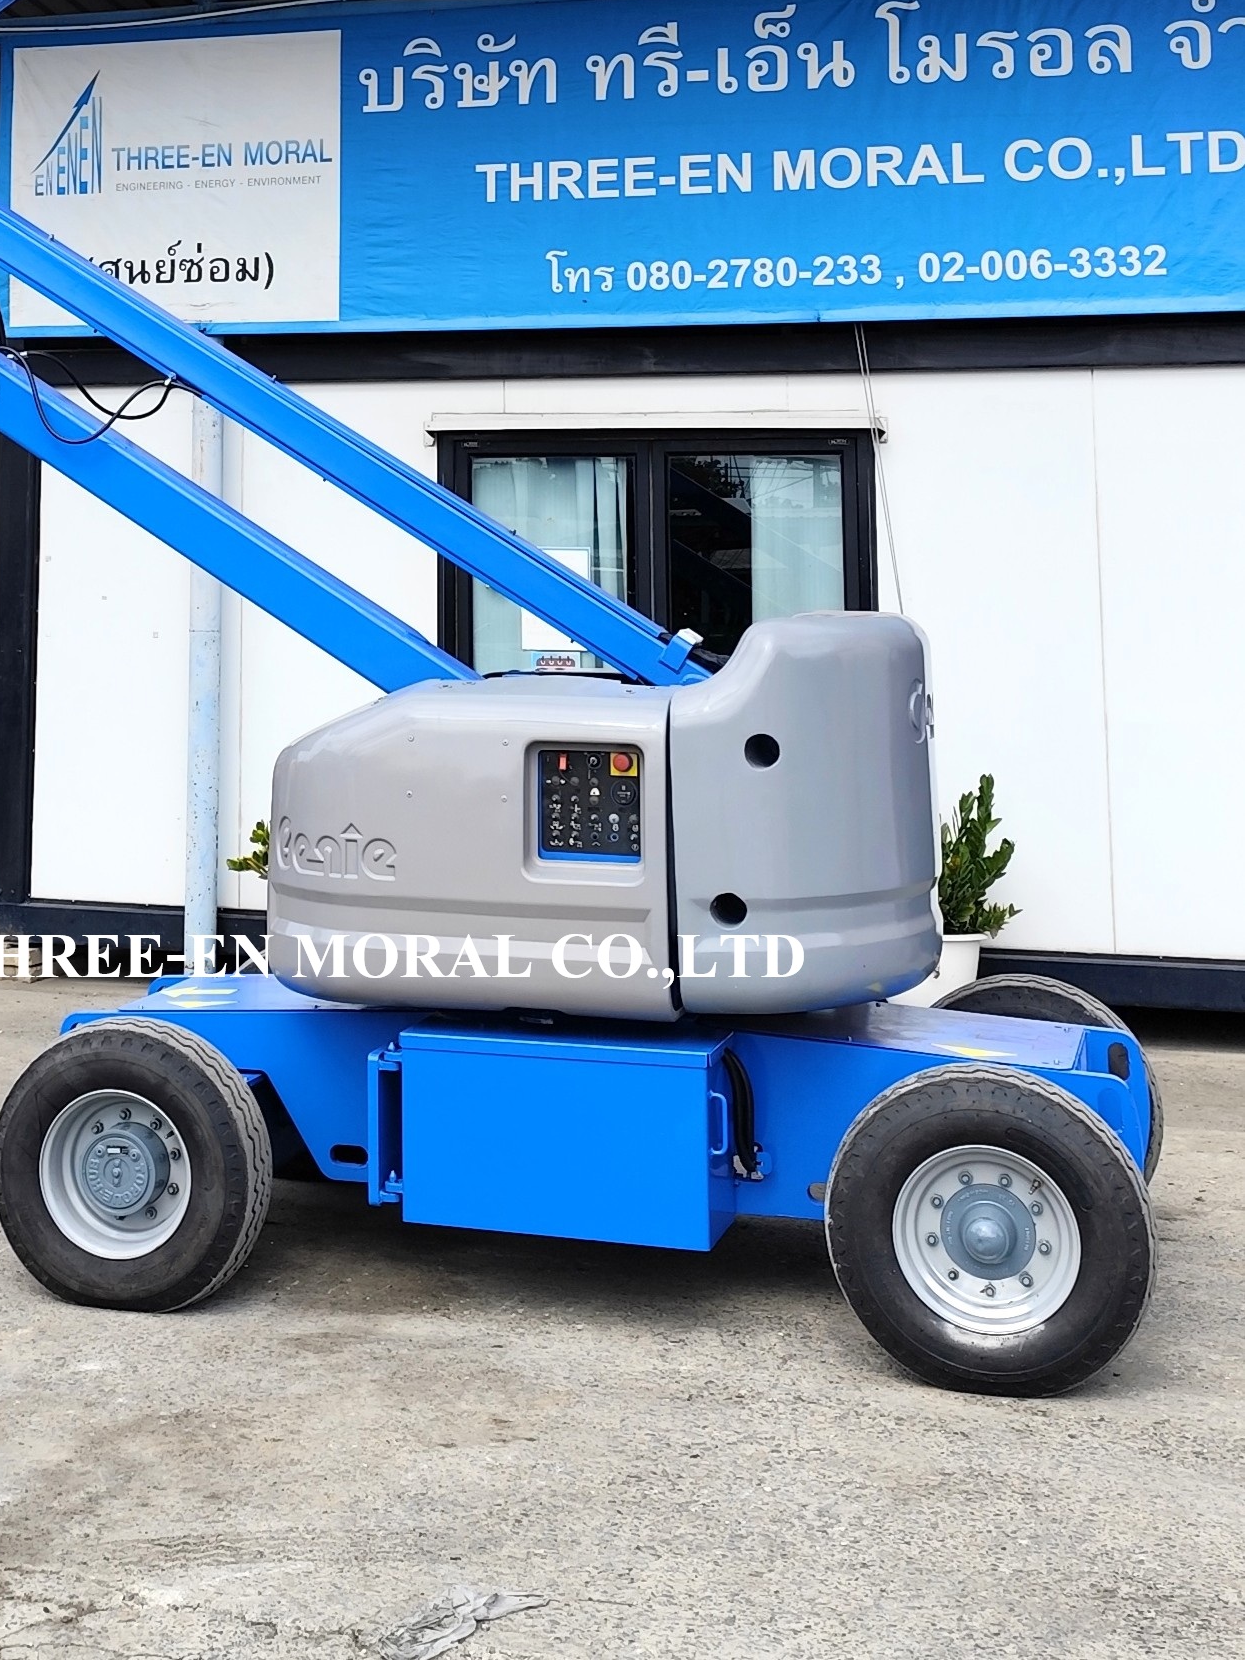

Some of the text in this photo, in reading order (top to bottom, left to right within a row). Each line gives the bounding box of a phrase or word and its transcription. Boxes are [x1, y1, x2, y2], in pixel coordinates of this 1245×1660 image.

[359, 34, 557, 113] บริษัท
[586, 4, 855, 101] ทรี-เอ็น
[875, 0, 1132, 84] โมรอล
[111, 139, 333, 171] THREE-EN MORAL
[475, 152, 752, 203] THREE-EN
[773, 142, 985, 191] MORAL
[116, 181, 183, 191] ENGINEERING
[195, 179, 236, 189] ENERGY
[247, 176, 322, 187] ENVIRONMENT
[545, 250, 615, 293] โทร
[626, 254, 882, 291] 080-2780-233
[918, 244, 1167, 283] 02-006-3332
